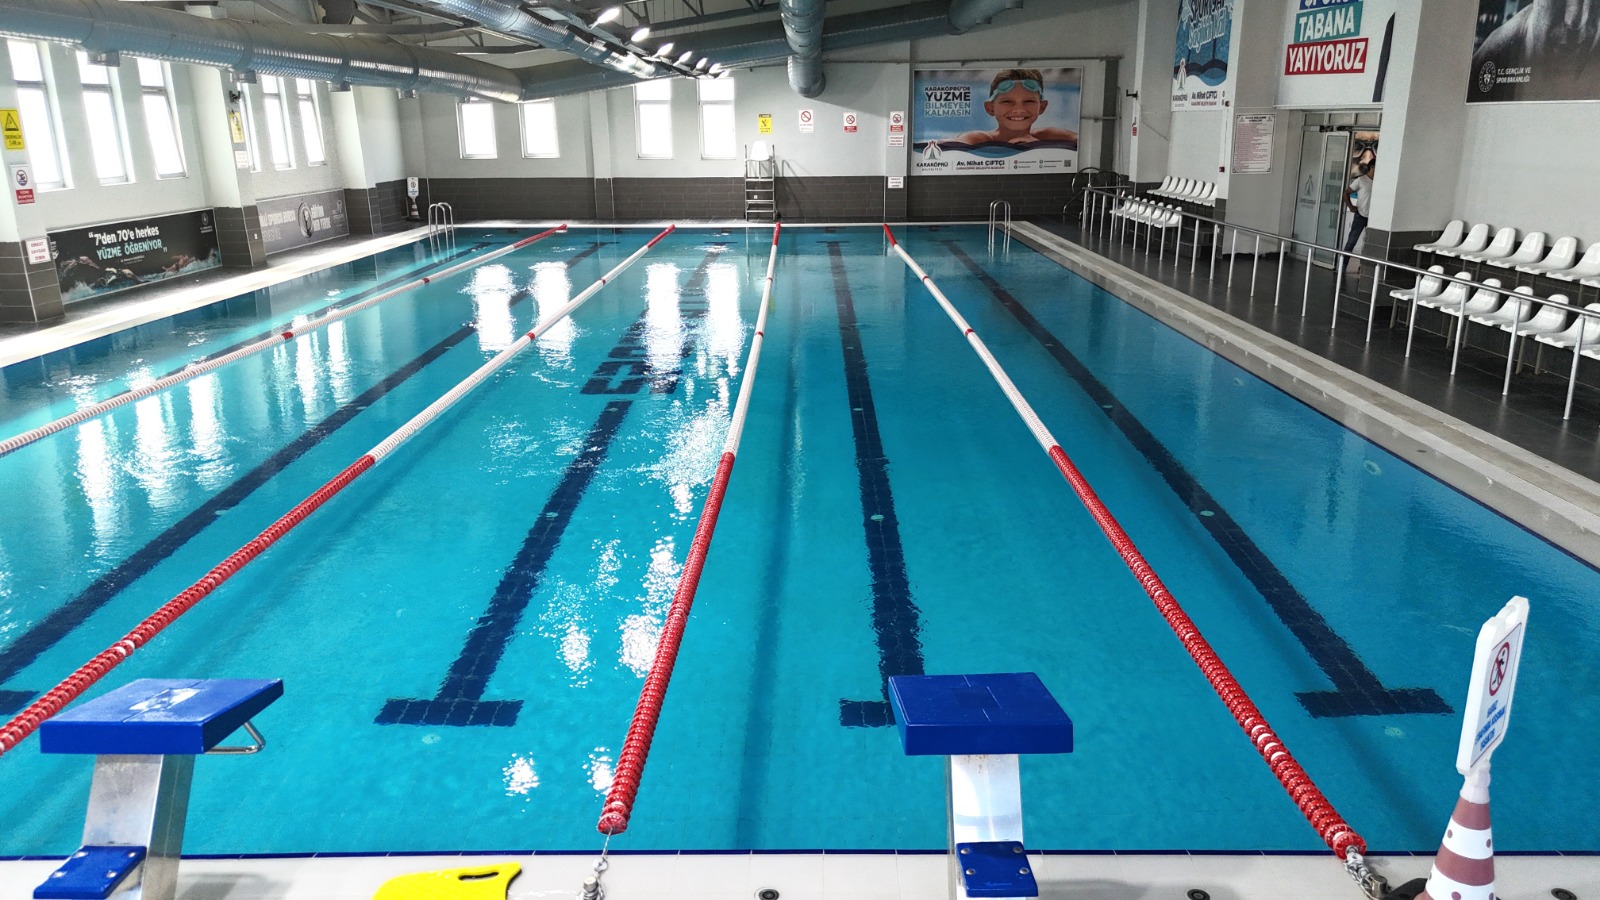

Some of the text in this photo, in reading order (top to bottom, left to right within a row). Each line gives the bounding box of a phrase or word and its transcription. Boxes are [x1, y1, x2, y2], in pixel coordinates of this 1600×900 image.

[1299, 6, 1355, 42] TABANA
[1289, 41, 1366, 72] YAYIYORUZ
[1525, 66, 1531, 74] VE
[925, 91, 971, 101] YÜZME
[135, 226, 159, 239] herkes
[96, 246, 123, 261] YÜZME
